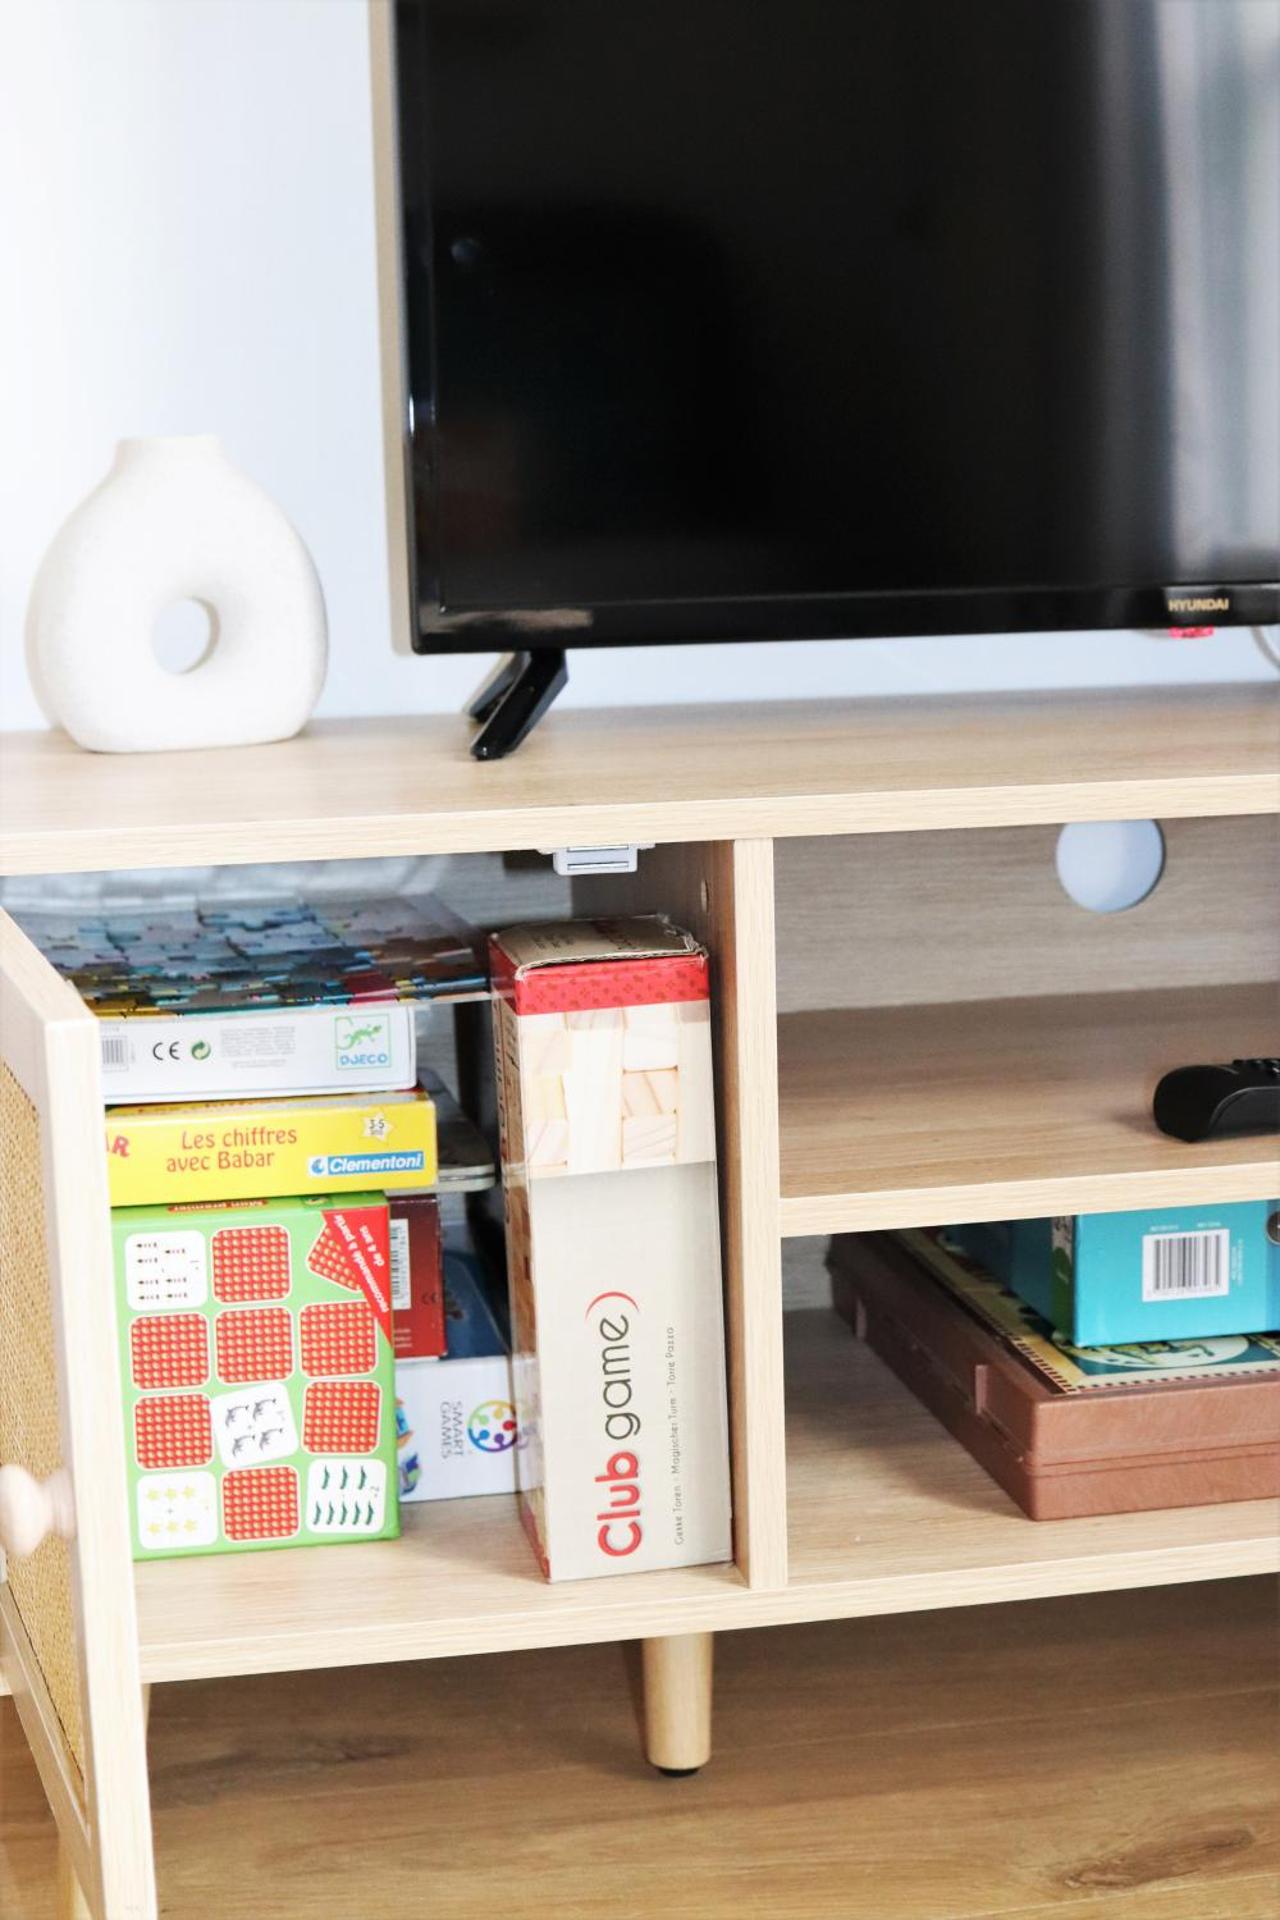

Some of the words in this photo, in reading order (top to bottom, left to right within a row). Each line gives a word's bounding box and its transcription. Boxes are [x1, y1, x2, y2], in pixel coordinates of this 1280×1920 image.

[1168, 598, 1229, 611] HYUNDAI
[340, 1054, 388, 1066] DJECO
[181, 1131, 215, 1150] Les
[222, 1126, 298, 1148] chiffres
[166, 1155, 211, 1173] avec
[217, 1150, 275, 1170] Babar
[329, 1153, 422, 1174] Clementoni
[334, 1214, 356, 1242] partir
[360, 1225, 374, 1243] ans
[367, 1243, 377, 1252] 4
[373, 1252, 385, 1267] de
[600, 1314, 641, 1440] game
[668, 1398, 678, 1420] Turm
[440, 1402, 451, 1459] GAMES
[453, 1401, 464, 1455] SMART
[595, 1451, 642, 1557] Club
